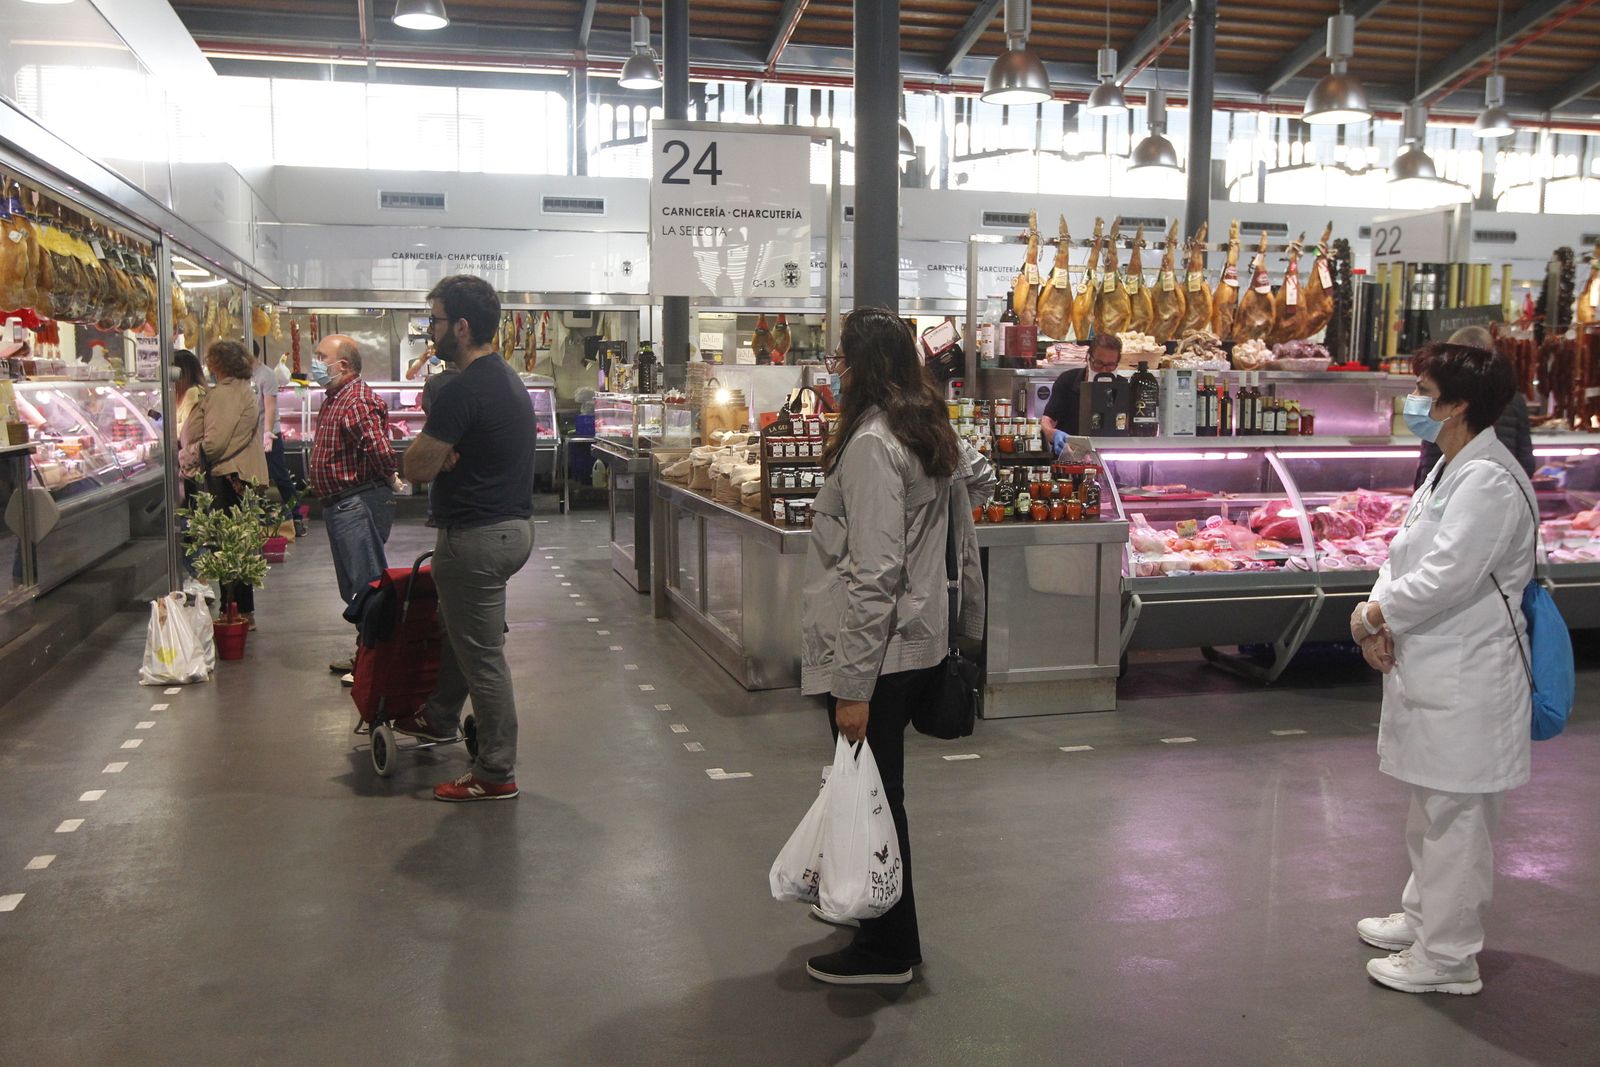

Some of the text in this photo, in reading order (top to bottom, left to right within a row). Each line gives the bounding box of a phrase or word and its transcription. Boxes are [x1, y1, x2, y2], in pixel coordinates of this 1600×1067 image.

[661, 139, 723, 186] 24
[662, 205, 803, 220] CARNICERÍA CHARCUTERÍA
[662, 225, 728, 237] LA SELECTA
[1374, 225, 1402, 257] 22
[391, 251, 504, 262] CARNICERÍA CHARCUTERÍA
